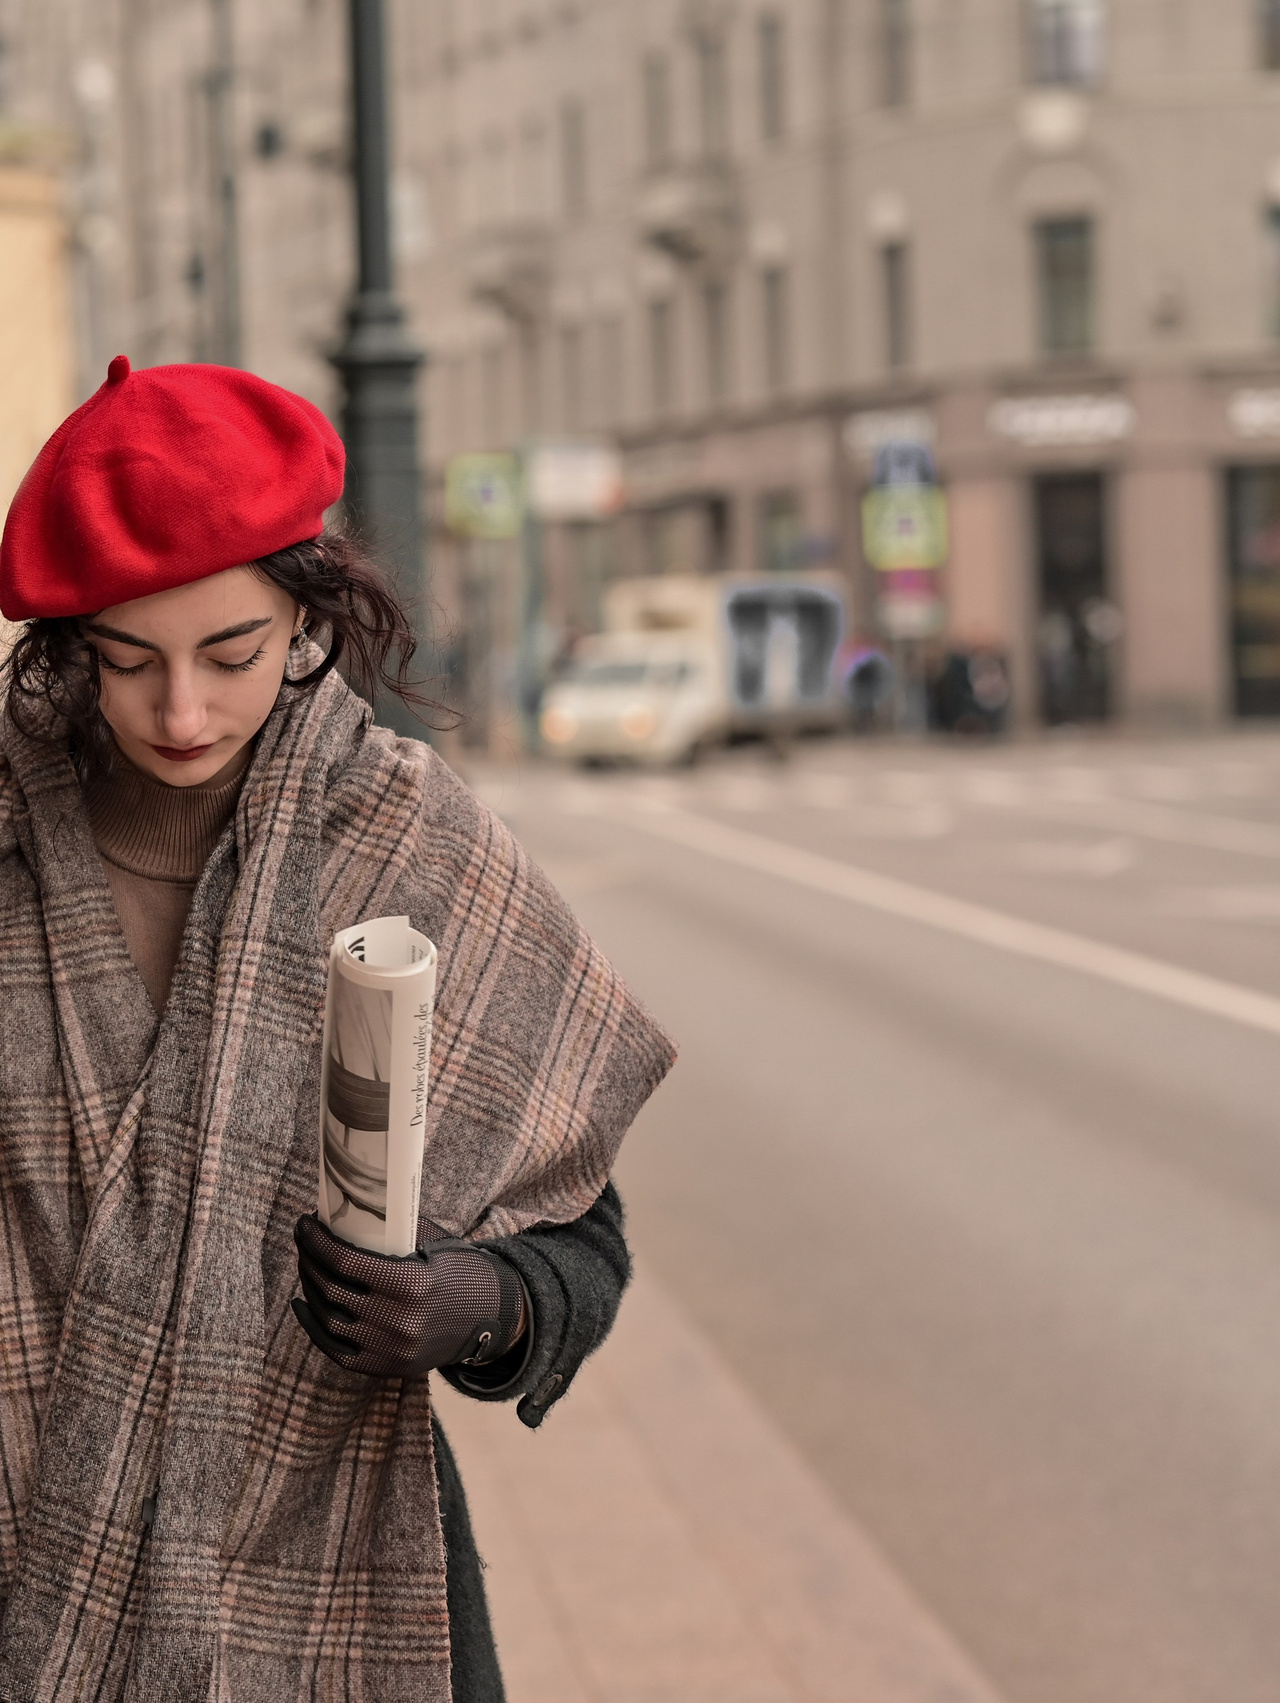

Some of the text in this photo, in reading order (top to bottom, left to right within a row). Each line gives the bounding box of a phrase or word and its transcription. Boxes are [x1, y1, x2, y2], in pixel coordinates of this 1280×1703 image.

[413, 1002, 429, 1020] des
[411, 1073, 426, 1103] robes
[410, 1104, 423, 1127] Des
